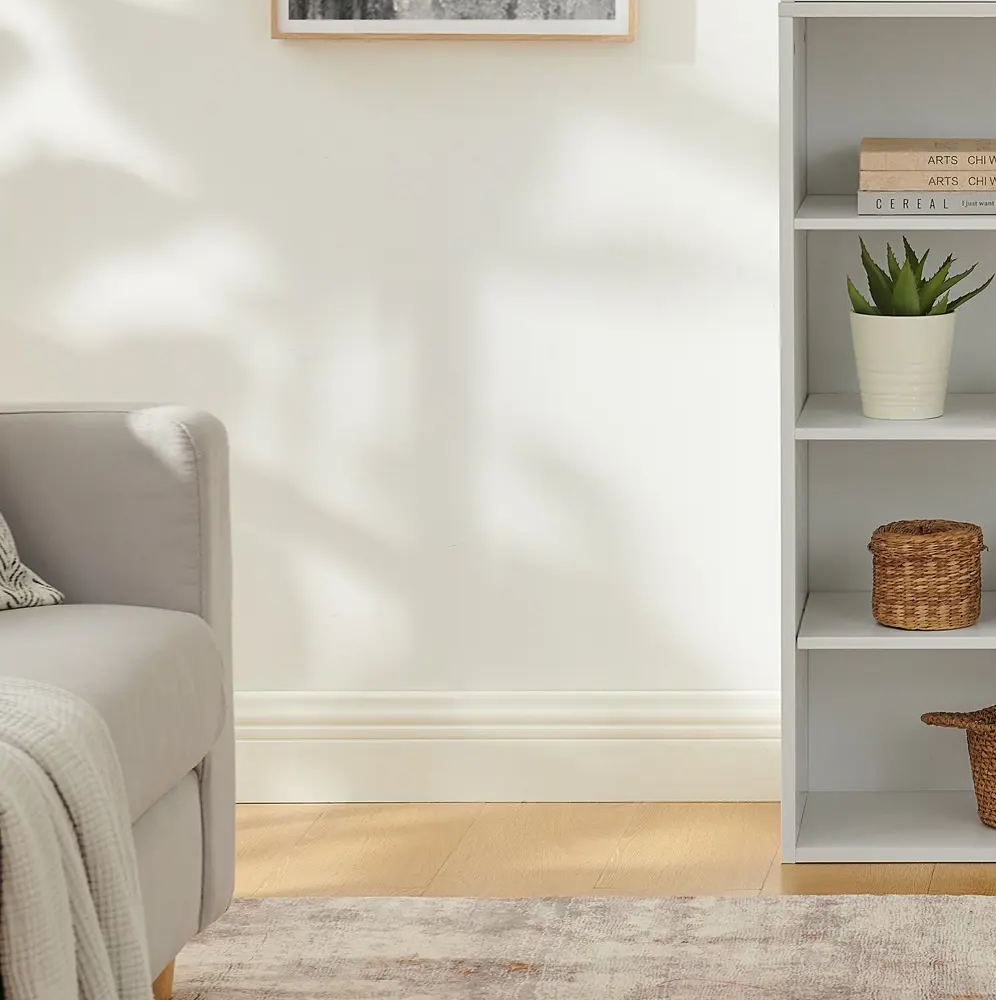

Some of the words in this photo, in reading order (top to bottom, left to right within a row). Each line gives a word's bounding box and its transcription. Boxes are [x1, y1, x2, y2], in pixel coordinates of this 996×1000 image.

[928, 155, 958, 165] ARTS
[967, 155, 986, 165] CHI
[928, 176, 959, 186] ARTS
[968, 176, 987, 186] CHI
[876, 198, 948, 210] CEREAL
